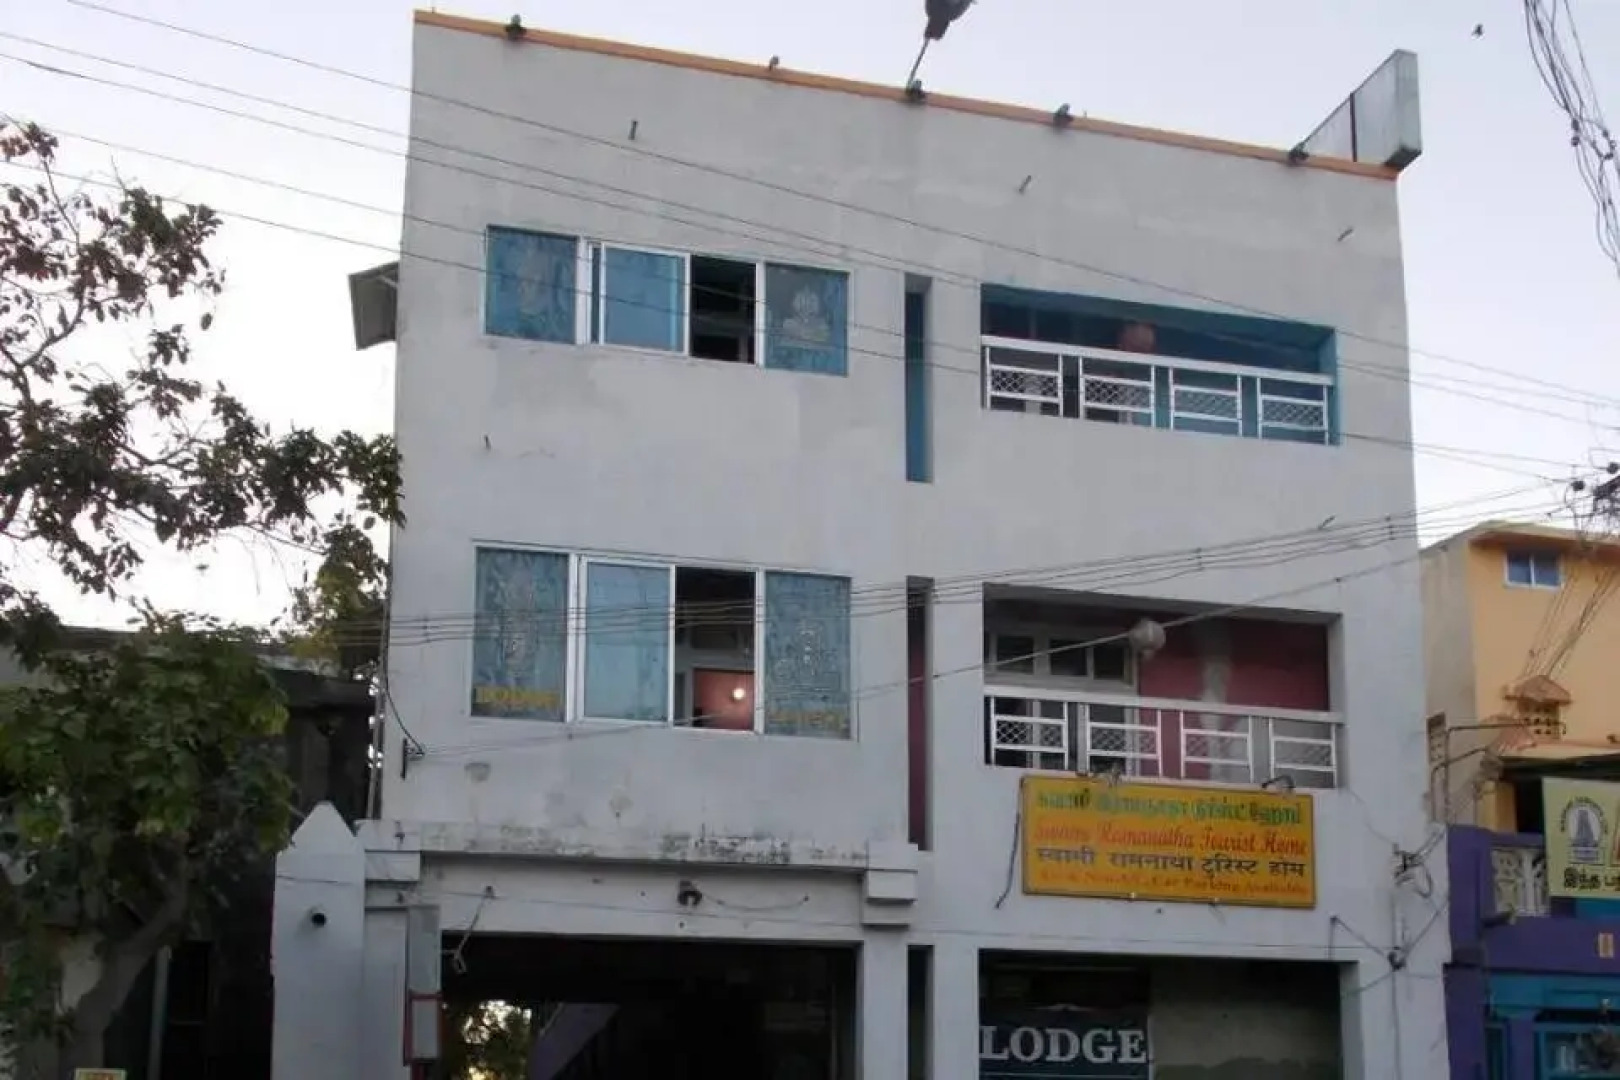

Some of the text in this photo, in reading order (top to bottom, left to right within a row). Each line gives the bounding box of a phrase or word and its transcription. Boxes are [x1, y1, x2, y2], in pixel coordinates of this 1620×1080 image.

[1200, 826, 1256, 853] Tourist
[1260, 829, 1309, 856] Home
[979, 1025, 1147, 1064] LODGE
